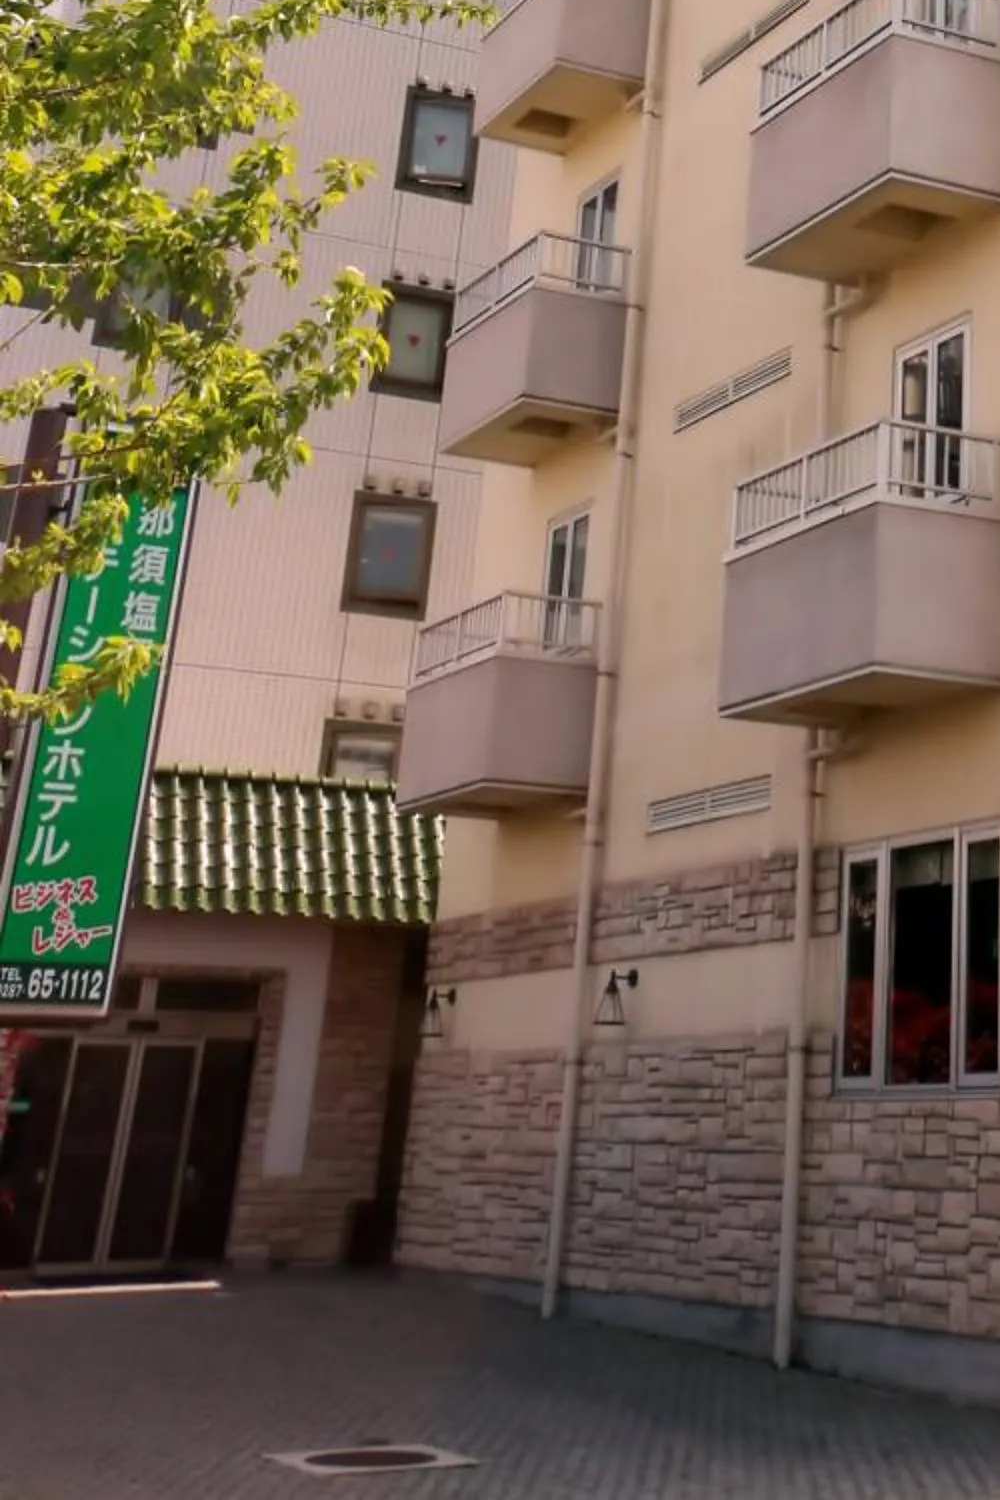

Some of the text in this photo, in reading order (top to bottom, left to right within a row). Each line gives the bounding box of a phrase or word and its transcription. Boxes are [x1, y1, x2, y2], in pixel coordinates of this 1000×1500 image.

[119, 497, 177, 658] 那須塩
[11, 875, 98, 912] ビジネス
[31, 925, 113, 954] レジャー
[0, 967, 22, 981] TEL
